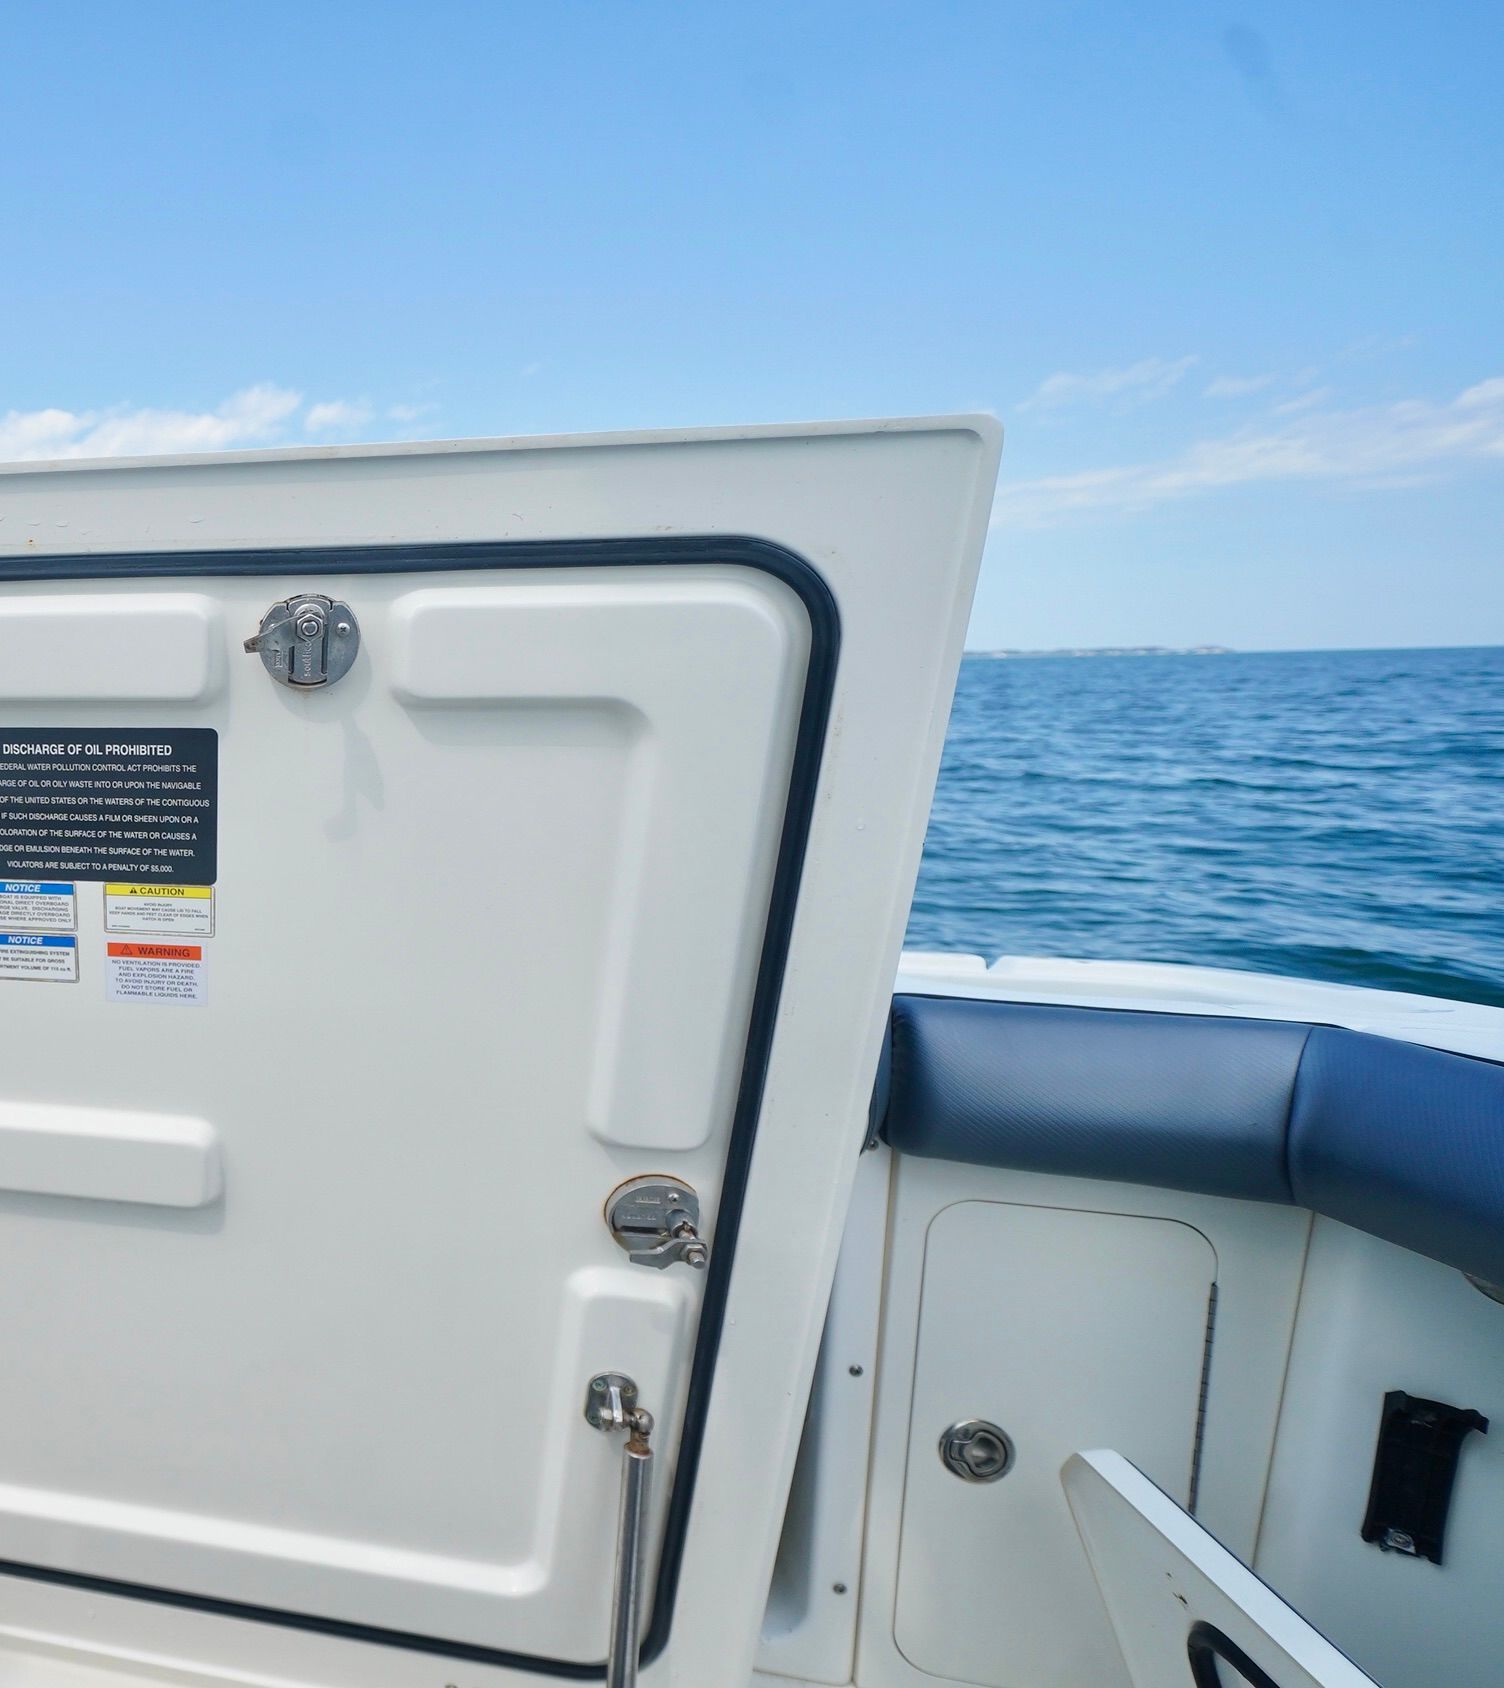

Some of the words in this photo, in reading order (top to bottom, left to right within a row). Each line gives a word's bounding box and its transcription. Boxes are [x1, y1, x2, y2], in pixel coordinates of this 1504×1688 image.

[3, 744, 64, 755] DISCHARGE
[67, 744, 81, 755] OF
[85, 744, 102, 755] OIL
[105, 744, 172, 756] PROHIBITED
[27, 763, 50, 771] WATER
[92, 764, 125, 772] CONTROL
[127, 764, 140, 772] ACT
[142, 764, 180, 772] PROHIBITS
[40, 780, 51, 788] OR
[52, 780, 67, 788] OILY
[68, 780, 92, 788] WASTE
[124, 781, 144, 789] UPON
[146, 781, 160, 789] THE
[161, 781, 201, 789] NAVIGABLE
[10, 796, 23, 804] THE
[51, 797, 76, 805] STATES
[104, 798, 133, 806] WATERS
[134, 798, 144, 806] OF
[146, 798, 160, 806] THE
[162, 799, 209, 807] CONTIGUOUS
[1, 812, 7, 820] IF
[28, 813, 68, 821] DISCHARGE
[104, 814, 120, 822] FILM
[159, 815, 179, 823] UPON
[38, 829, 47, 837] OF
[64, 830, 95, 838] SURFACE
[123, 831, 148, 839] WATER
[161, 832, 190, 840] CAUSES
[191, 832, 196, 840] A
[25, 845, 60, 853] EMULSION
[61, 846, 92, 854] BENEATH
[108, 847, 140, 855] SURFACE
[153, 848, 167, 856] THE
[169, 848, 195, 856] WATER.
[7, 861, 43, 869] VIOLATORS
[45, 862, 58, 870] ARE
[60, 862, 89, 870] SUBJECT
[91, 863, 101, 871] TO
[102, 863, 107, 871] A
[108, 863, 138, 872] PENALTY
[139, 864, 149, 872] OF
[150, 864, 173, 872] $5,000.
[5, 884, 41, 892] NOTICE
[8, 936, 43, 944] NOTICE
[138, 947, 190, 957] WARNING
